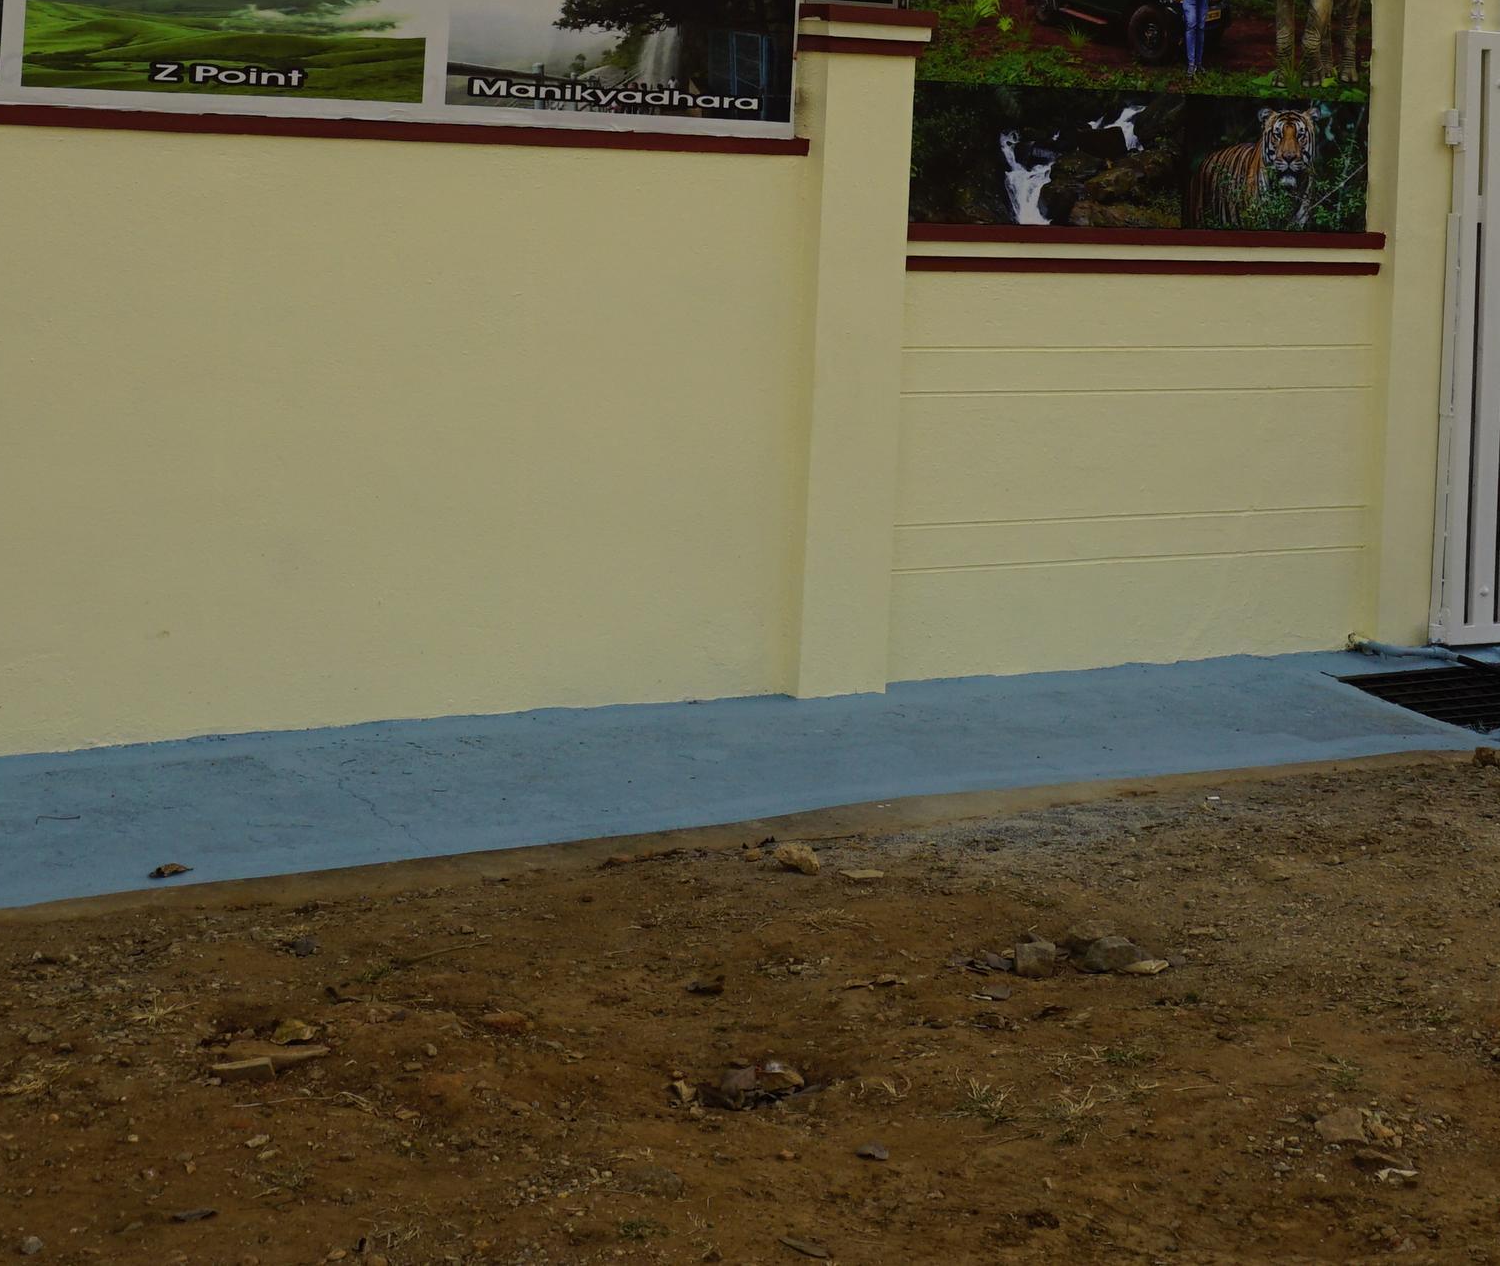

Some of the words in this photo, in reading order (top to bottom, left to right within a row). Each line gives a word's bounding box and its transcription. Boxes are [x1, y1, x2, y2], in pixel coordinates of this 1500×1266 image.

[153, 65, 182, 83] Z
[194, 66, 304, 88] Point
[471, 78, 761, 112] Manikyadhara
